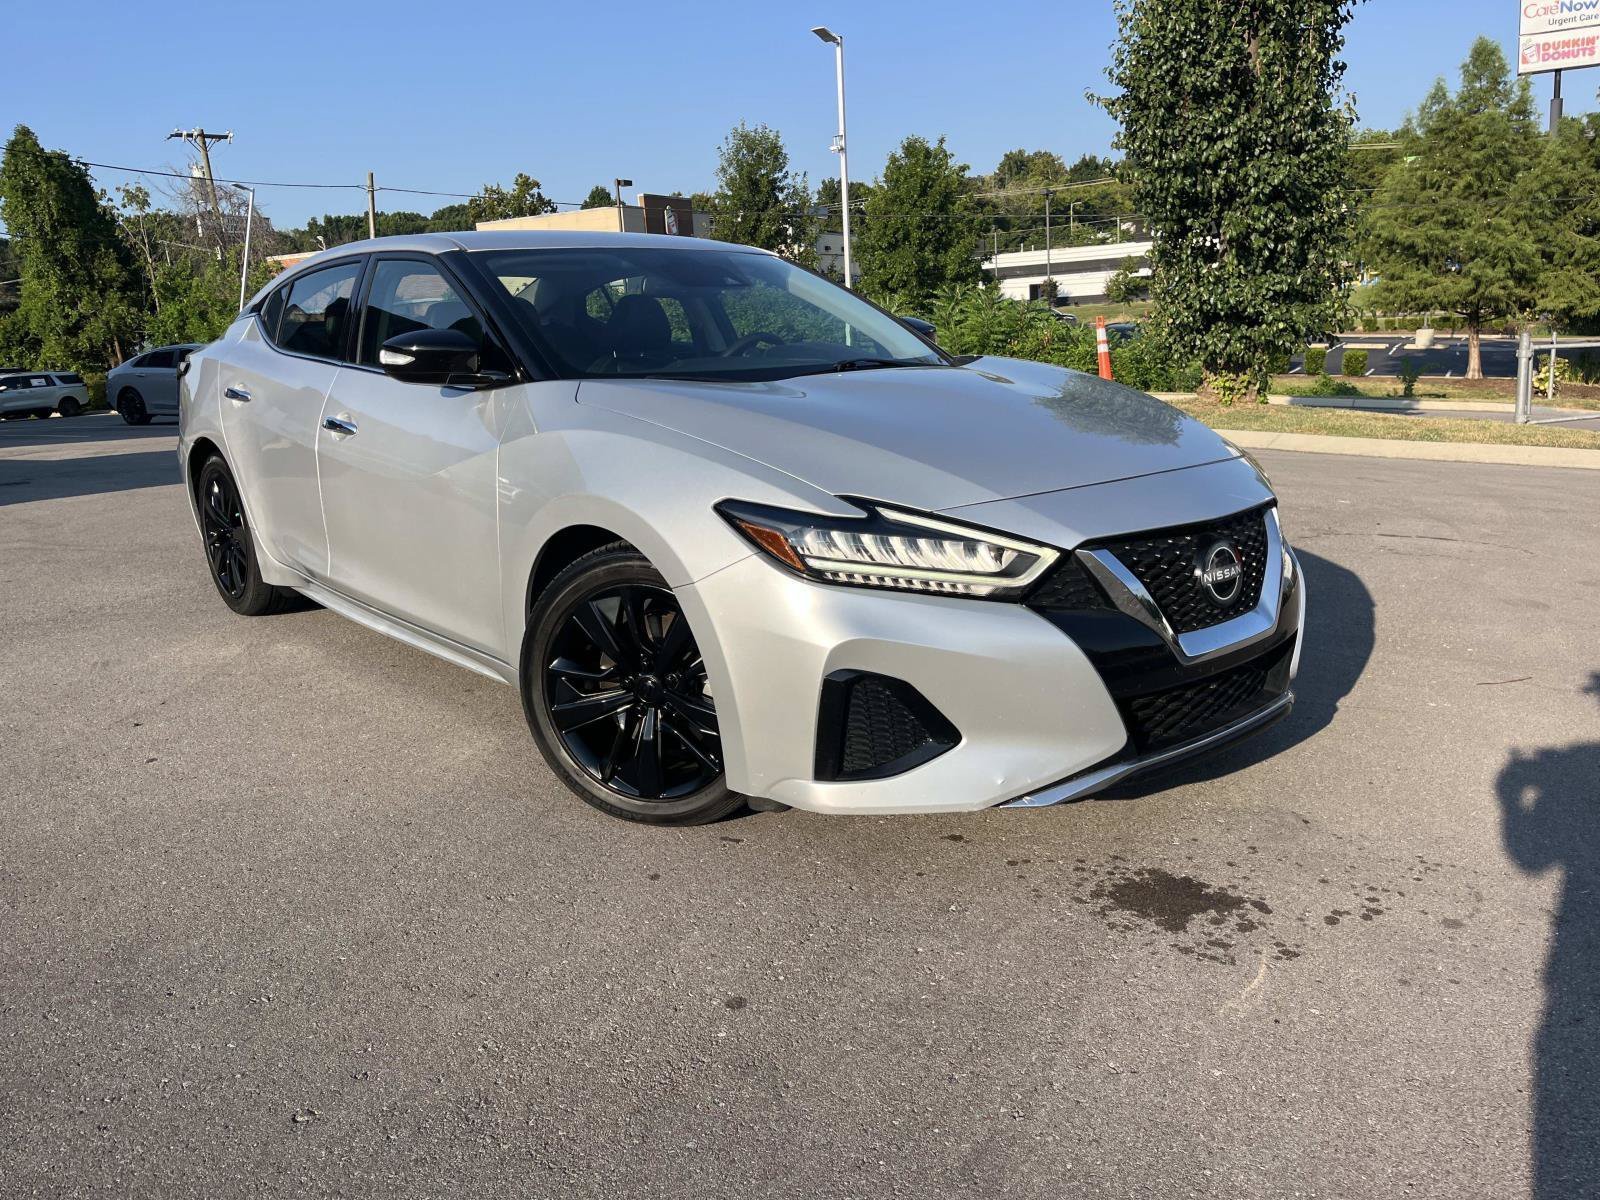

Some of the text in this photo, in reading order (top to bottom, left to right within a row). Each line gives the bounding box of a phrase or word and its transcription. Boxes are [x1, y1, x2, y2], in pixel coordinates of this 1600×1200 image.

[1548, 13, 1600, 26] Urgent Care
[1542, 36, 1600, 51] DUNKIN'
[1542, 46, 1596, 62] DONUTS
[1203, 565, 1241, 582] NISSAN
